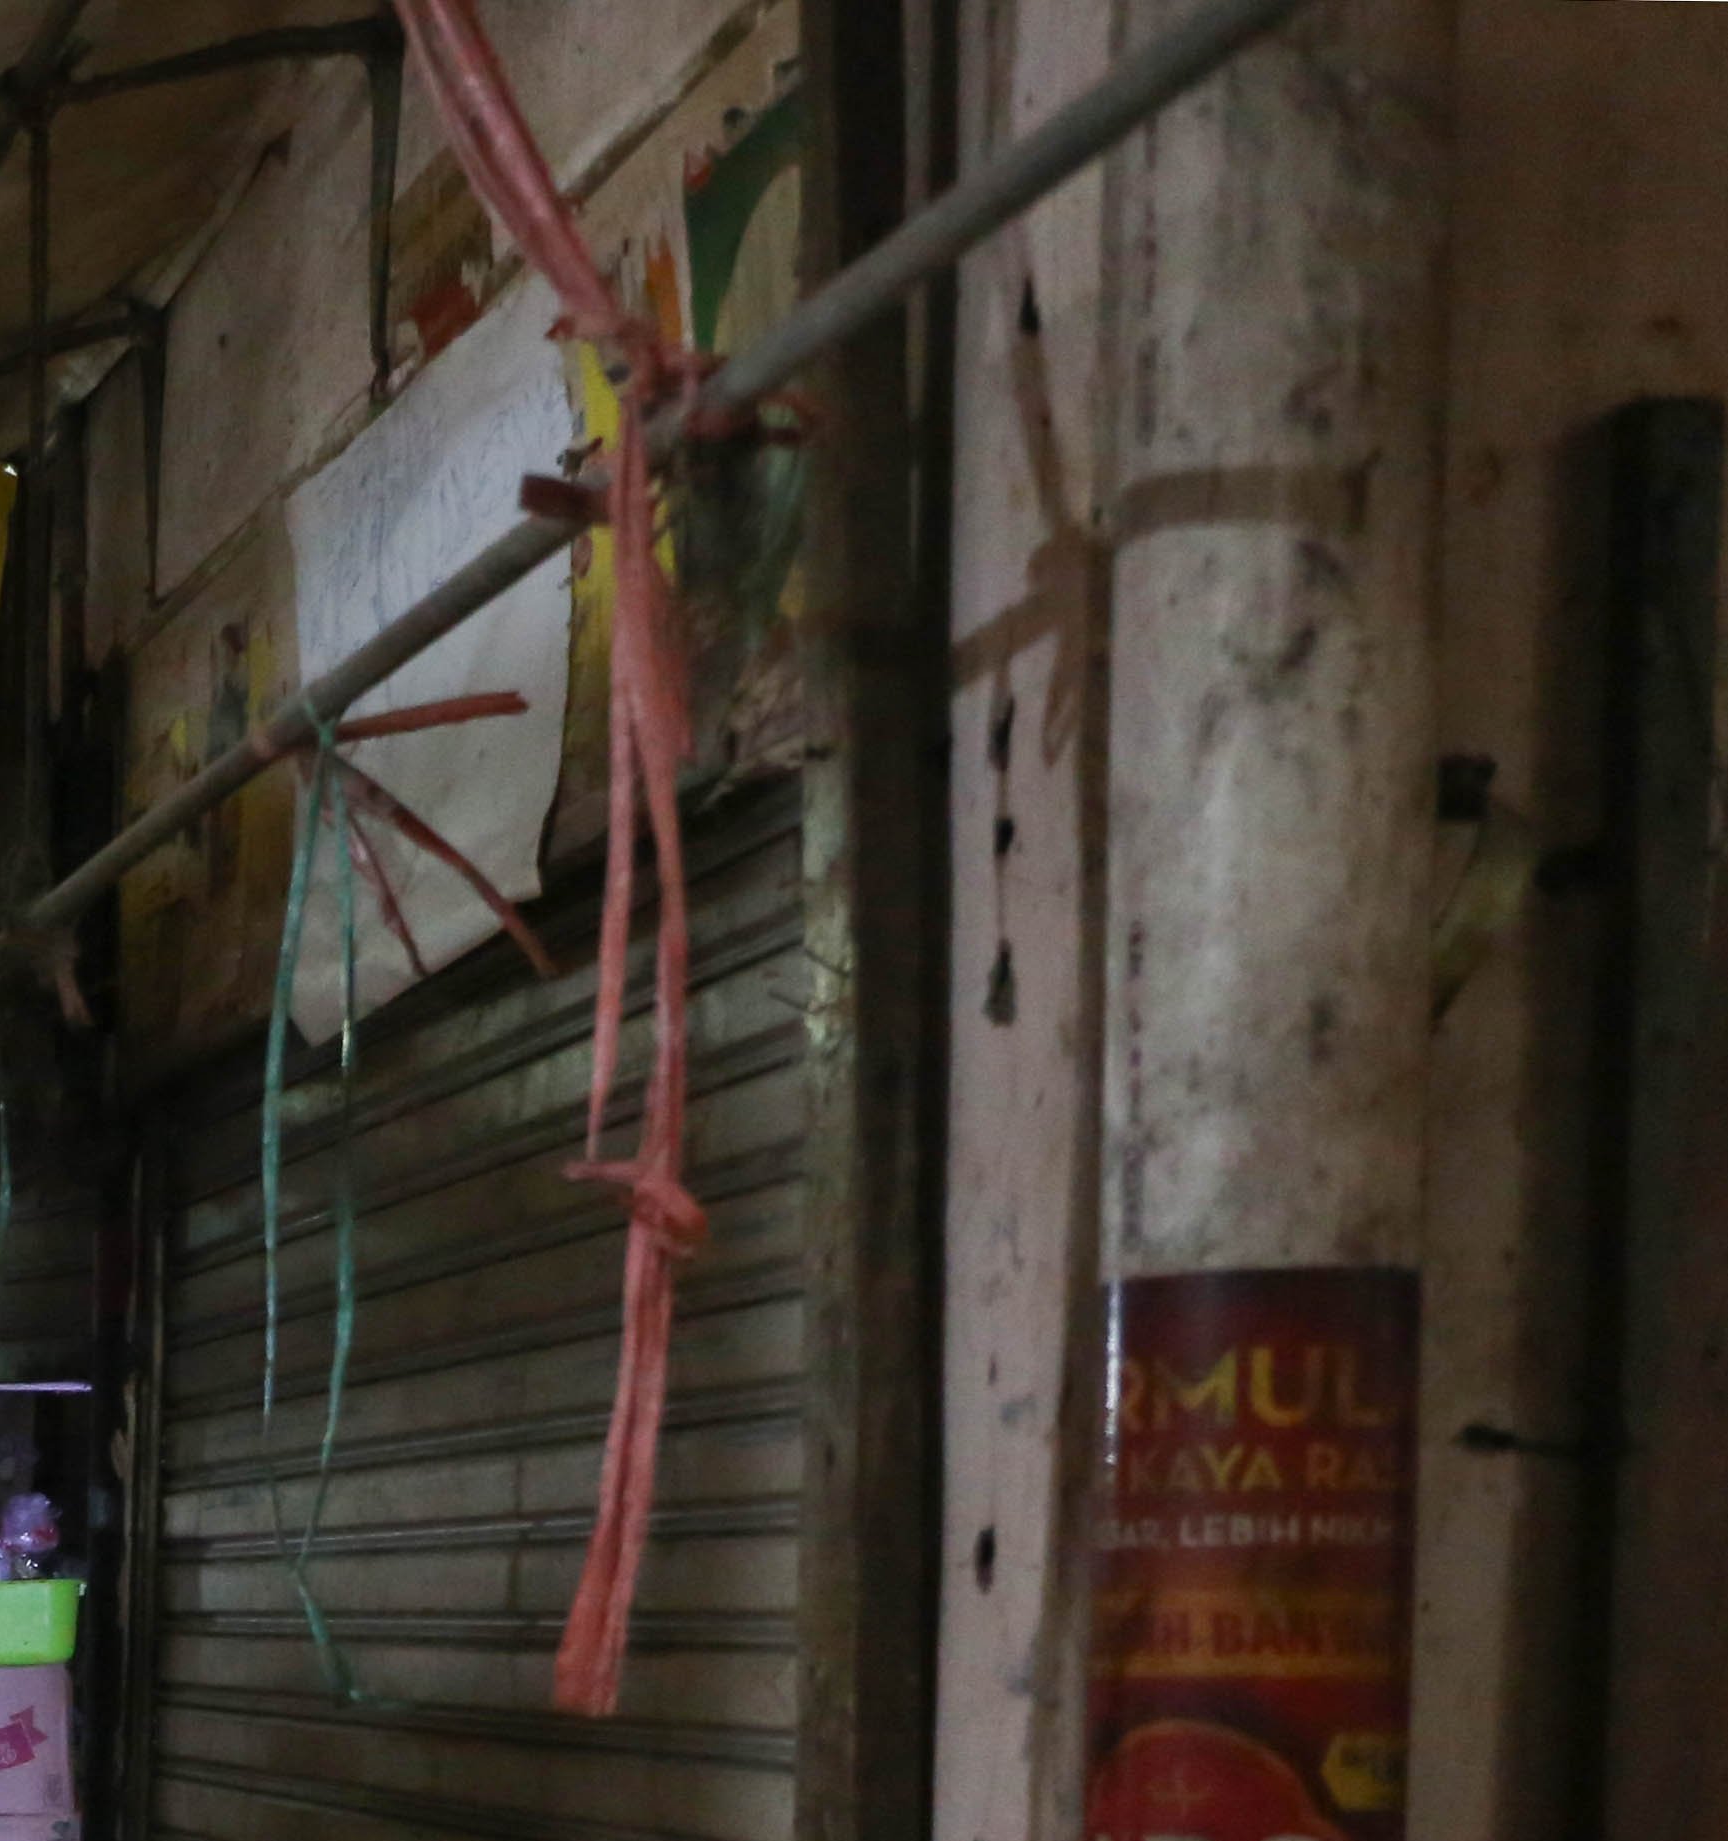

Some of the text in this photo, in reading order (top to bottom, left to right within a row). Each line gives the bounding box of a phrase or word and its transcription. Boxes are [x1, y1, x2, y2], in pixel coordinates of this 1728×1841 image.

[1129, 1443, 1388, 1493] KAYA RA
[1179, 1513, 1301, 1549] LEBIH
